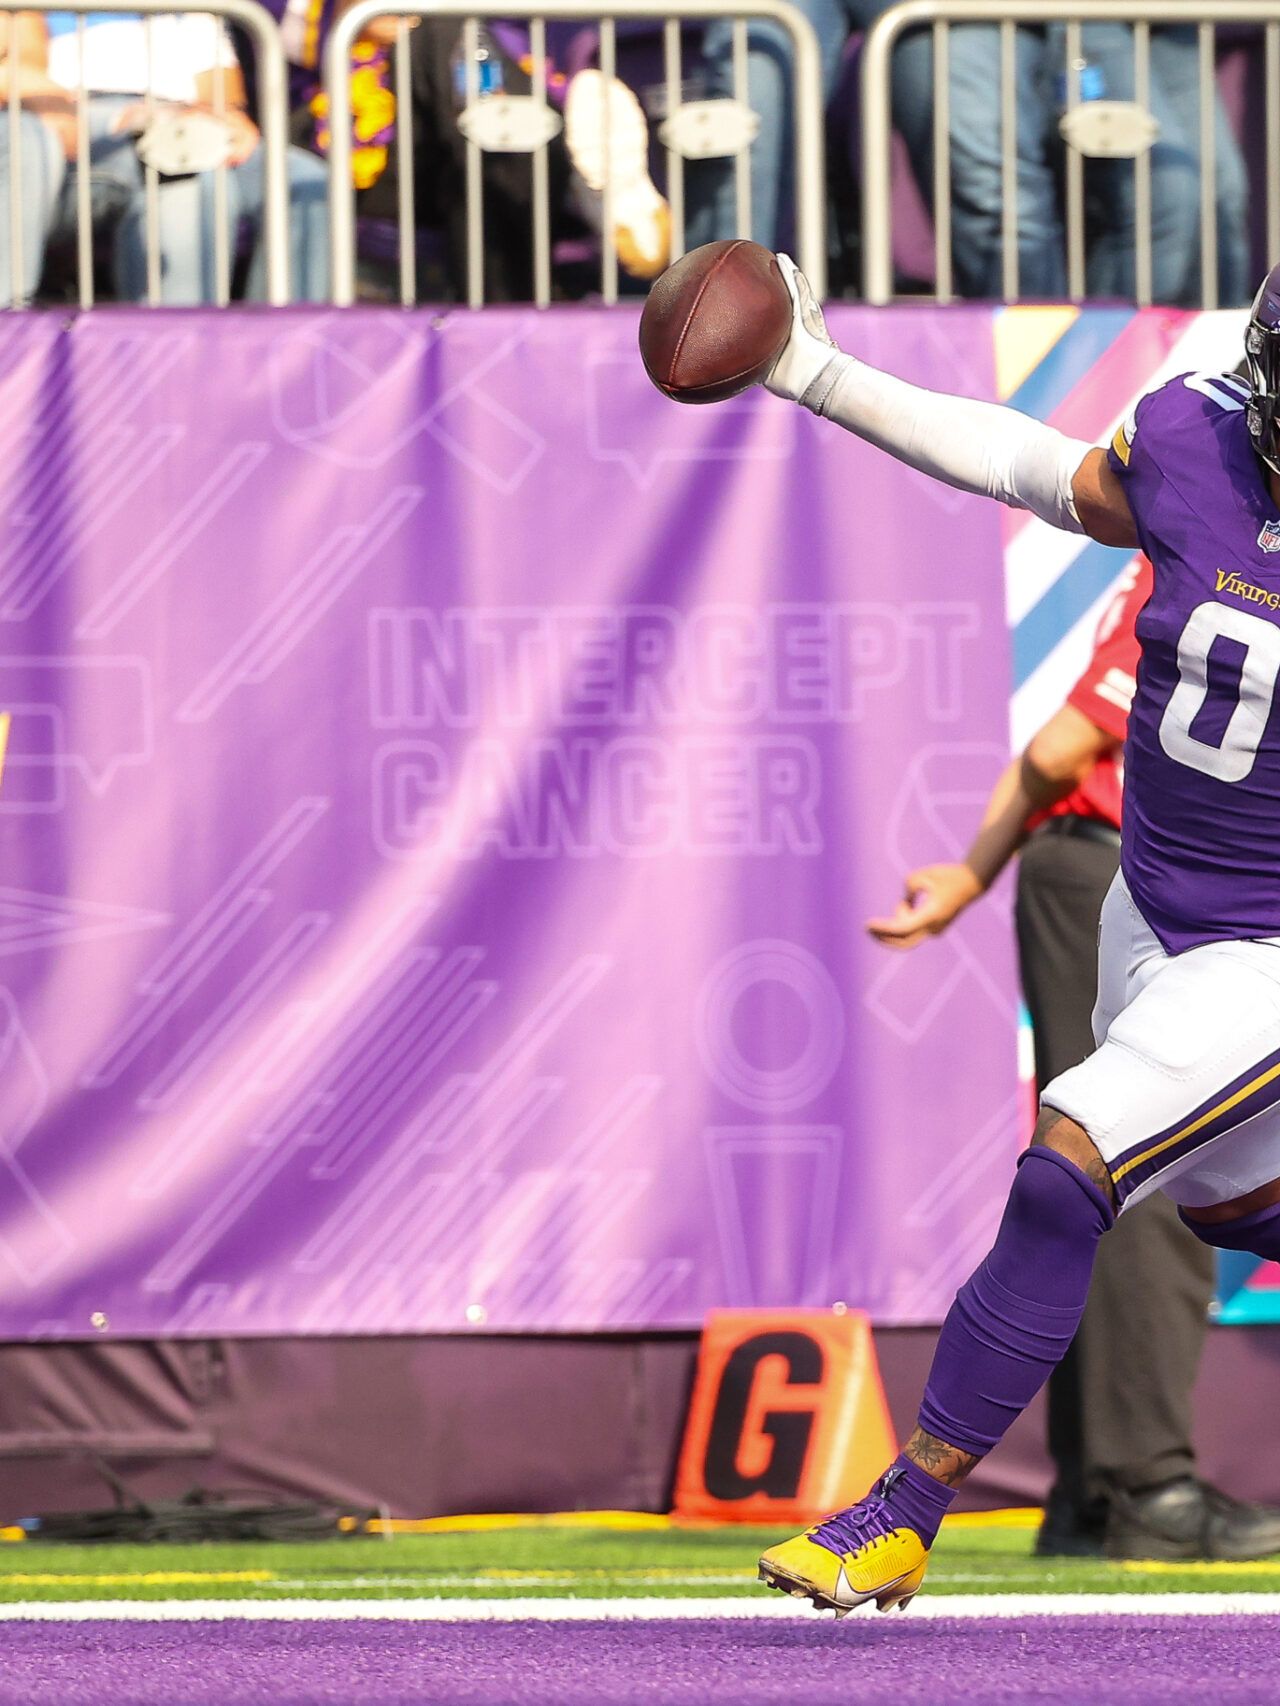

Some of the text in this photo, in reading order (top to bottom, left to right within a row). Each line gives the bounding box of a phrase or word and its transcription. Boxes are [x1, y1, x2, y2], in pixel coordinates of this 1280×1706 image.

[1262, 531, 1280, 548] NFL
[367, 601, 980, 729] INTERCEPT
[371, 734, 824, 861] CANCER
[704, 1331, 824, 1500] G
